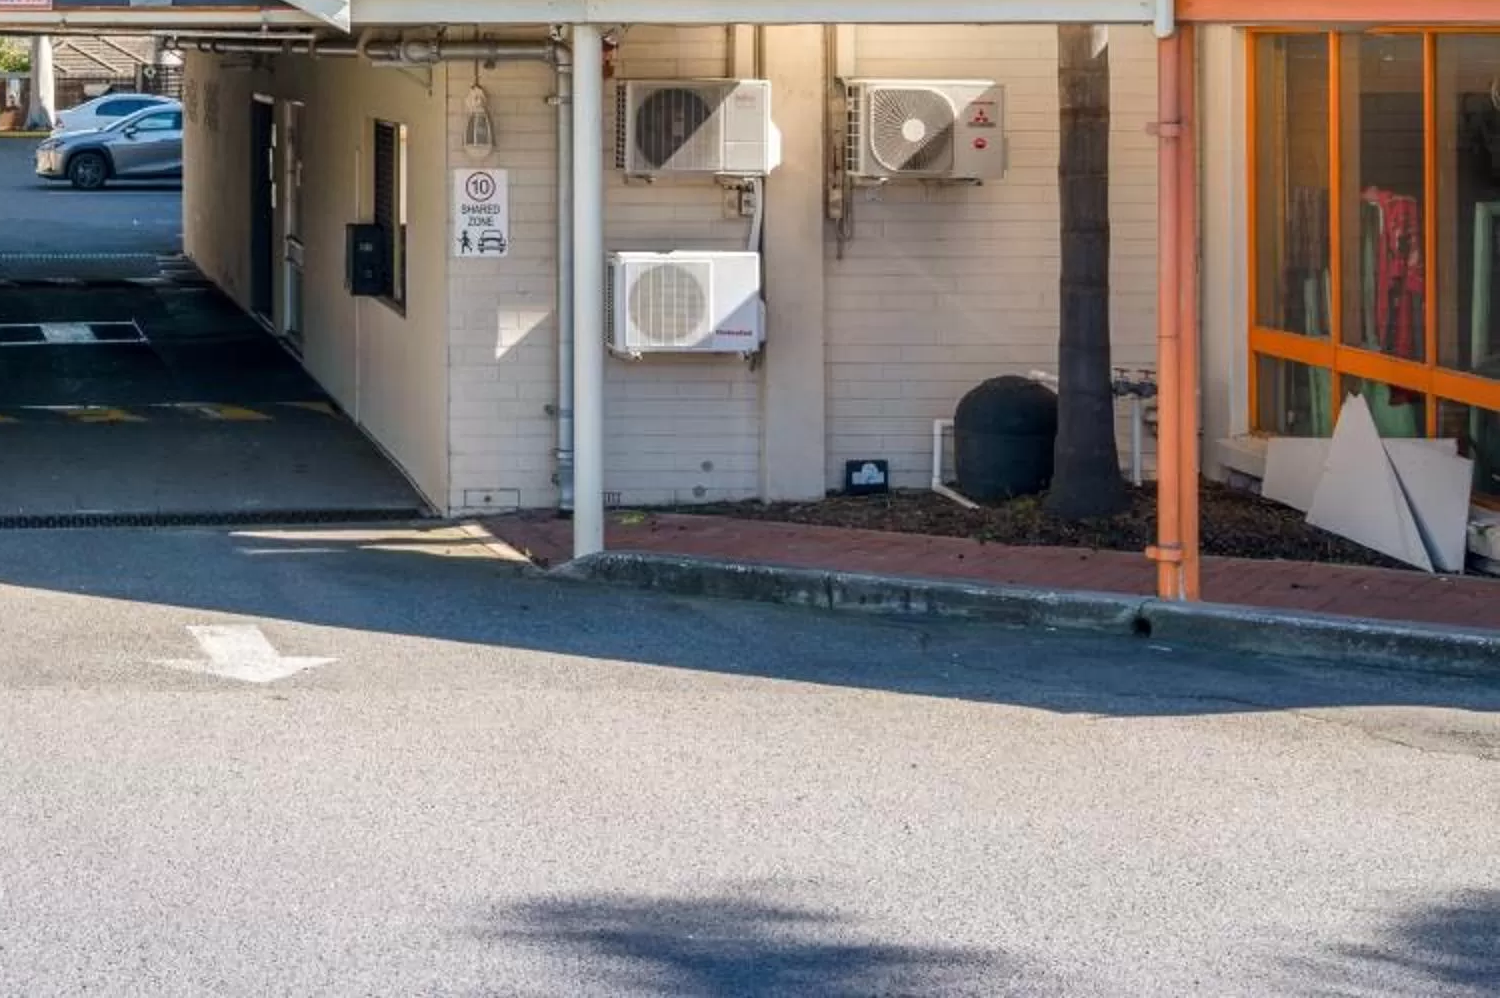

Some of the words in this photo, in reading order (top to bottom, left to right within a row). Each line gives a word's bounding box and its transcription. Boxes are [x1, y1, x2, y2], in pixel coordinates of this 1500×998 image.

[472, 179, 490, 195] 10
[461, 203, 501, 215] SHARED
[467, 216, 495, 227] ZONE
